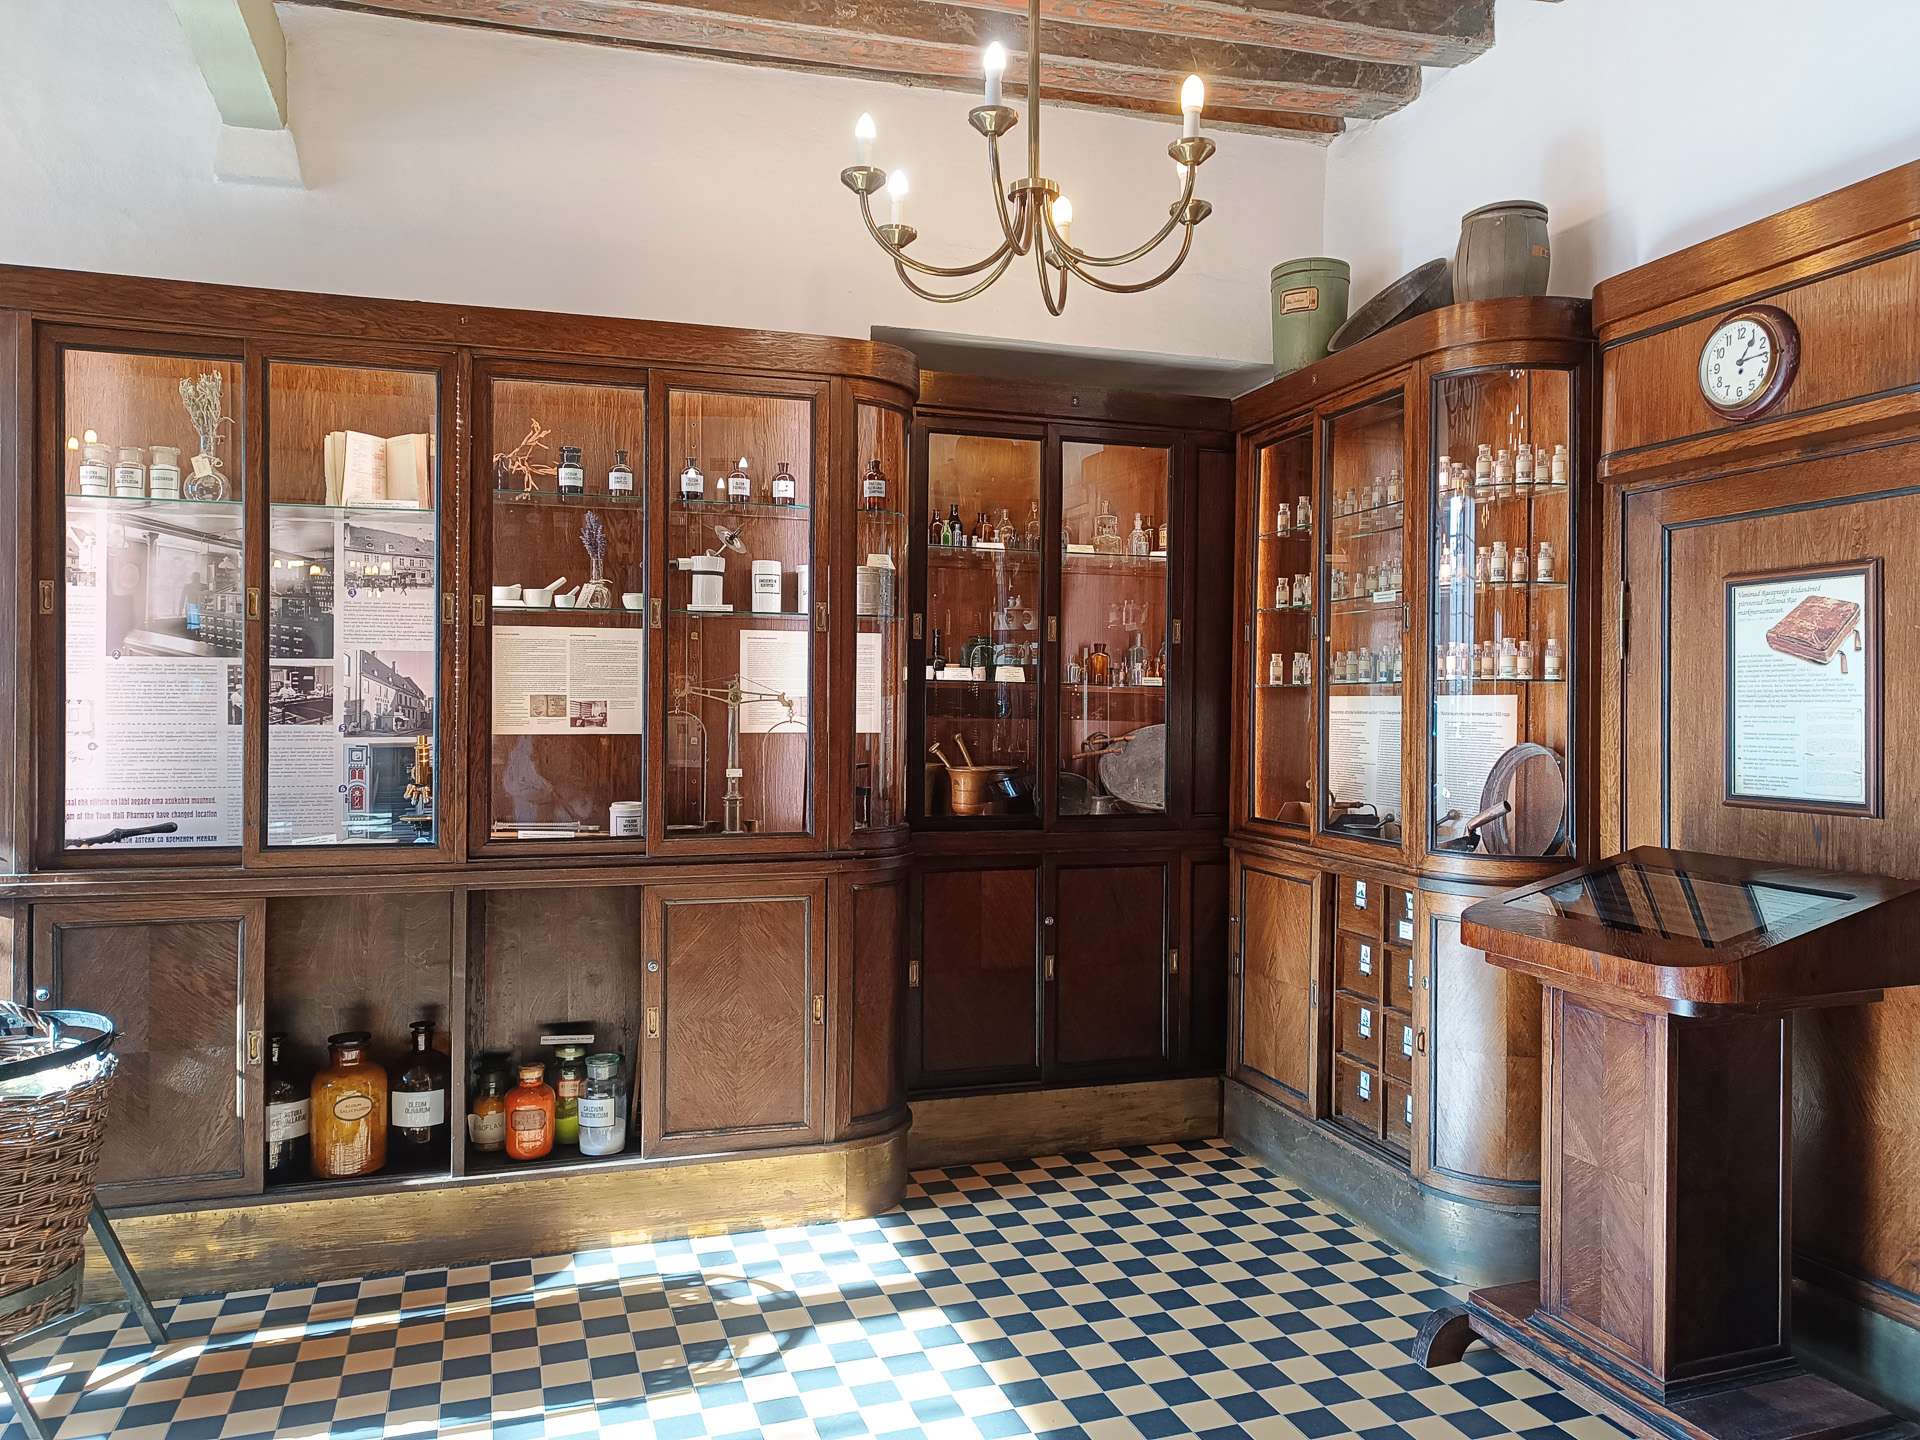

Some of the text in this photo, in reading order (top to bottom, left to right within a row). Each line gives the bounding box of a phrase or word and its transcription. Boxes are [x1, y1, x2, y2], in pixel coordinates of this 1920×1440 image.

[1737, 327, 1747, 340] 12
[1725, 334, 1732, 346] 11
[1759, 336, 1767, 349] 2
[1716, 347, 1725, 359] 10
[1762, 352, 1768, 364] 3
[1713, 363, 1720, 374] 9
[1758, 367, 1764, 378] 4
[1716, 376, 1723, 388] 8
[1748, 380, 1756, 391] 5
[1724, 385, 1731, 396] 7
[1736, 386, 1743, 397] 6
[131, 797, 151, 806] aegade
[113, 811, 124, 819] Hall
[126, 811, 154, 820] Pharmacy
[156, 810, 170, 819] have
[171, 810, 194, 819] changed
